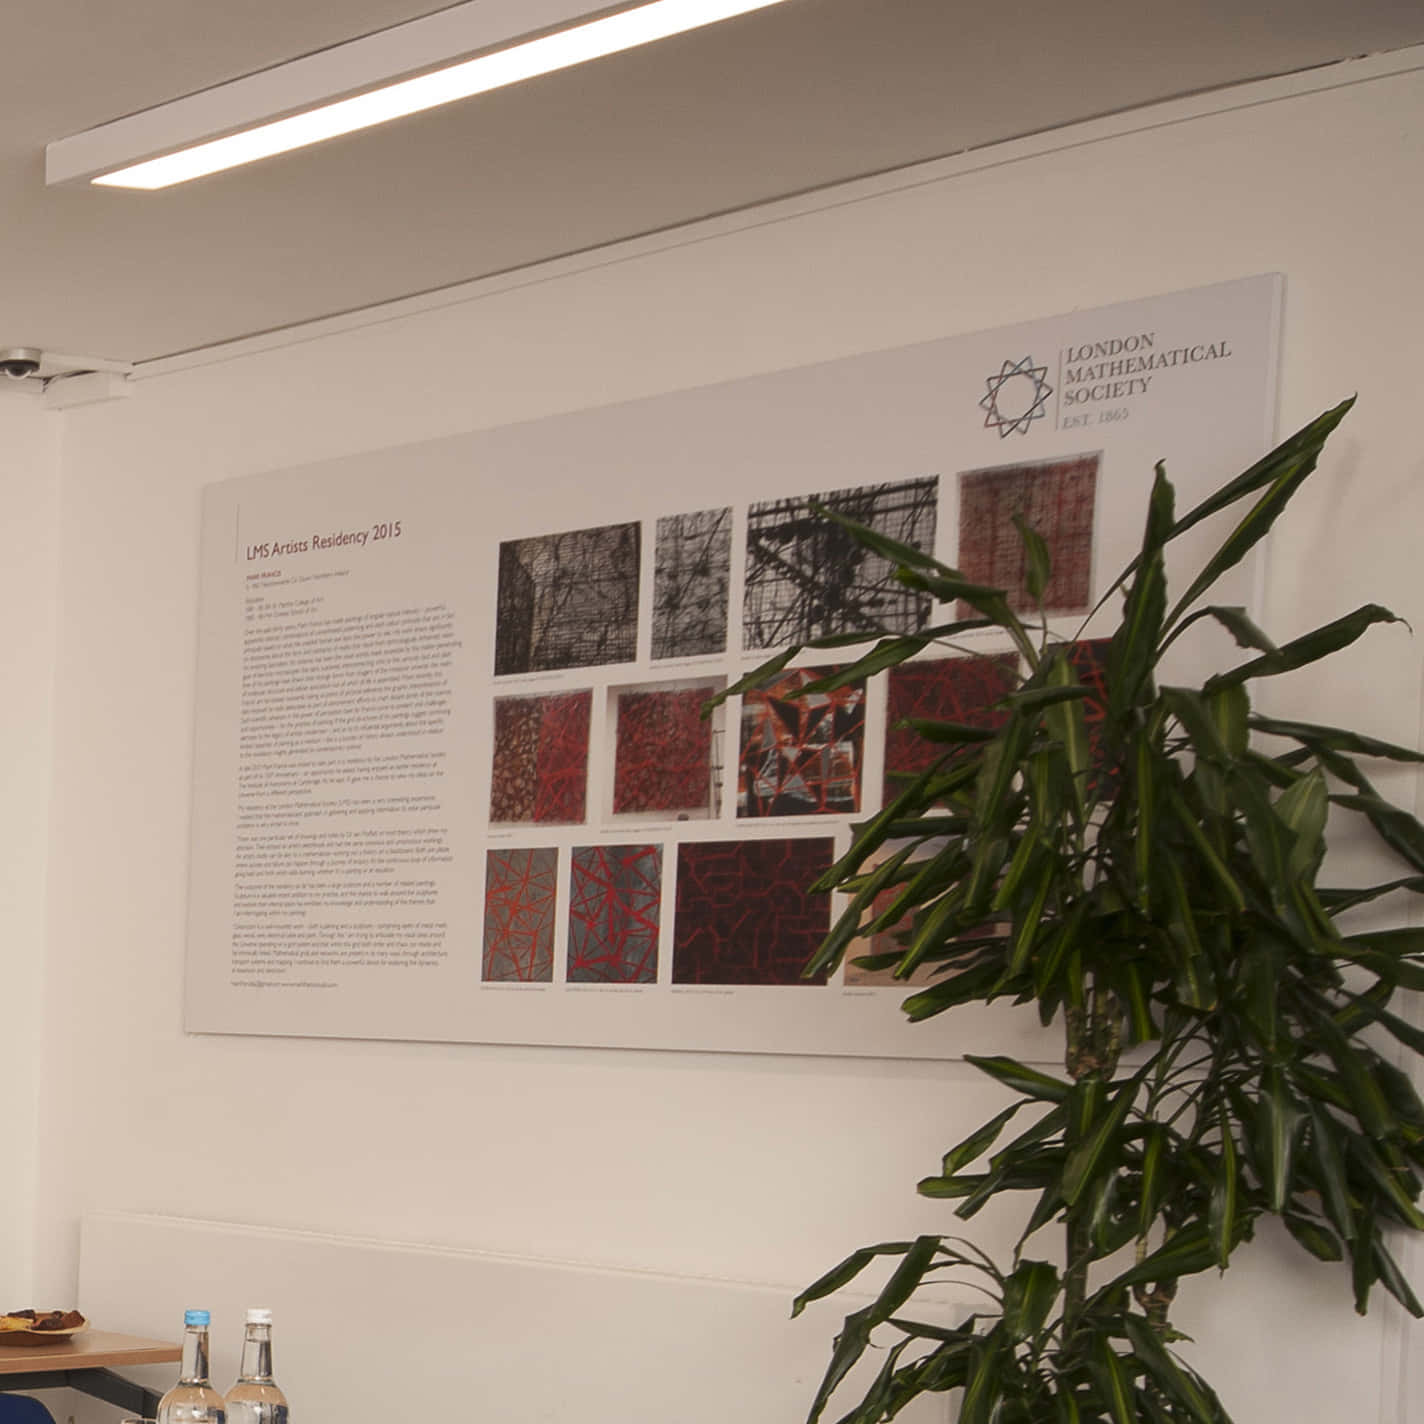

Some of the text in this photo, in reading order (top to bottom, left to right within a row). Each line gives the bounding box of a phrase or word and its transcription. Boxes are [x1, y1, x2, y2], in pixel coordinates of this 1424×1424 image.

[1064, 332, 1155, 364] LONDON
[1064, 340, 1233, 385] MATHEMATICAL
[1063, 375, 1153, 407] SOCIETY
[246, 520, 402, 561] LMS Artists Residency 2015
